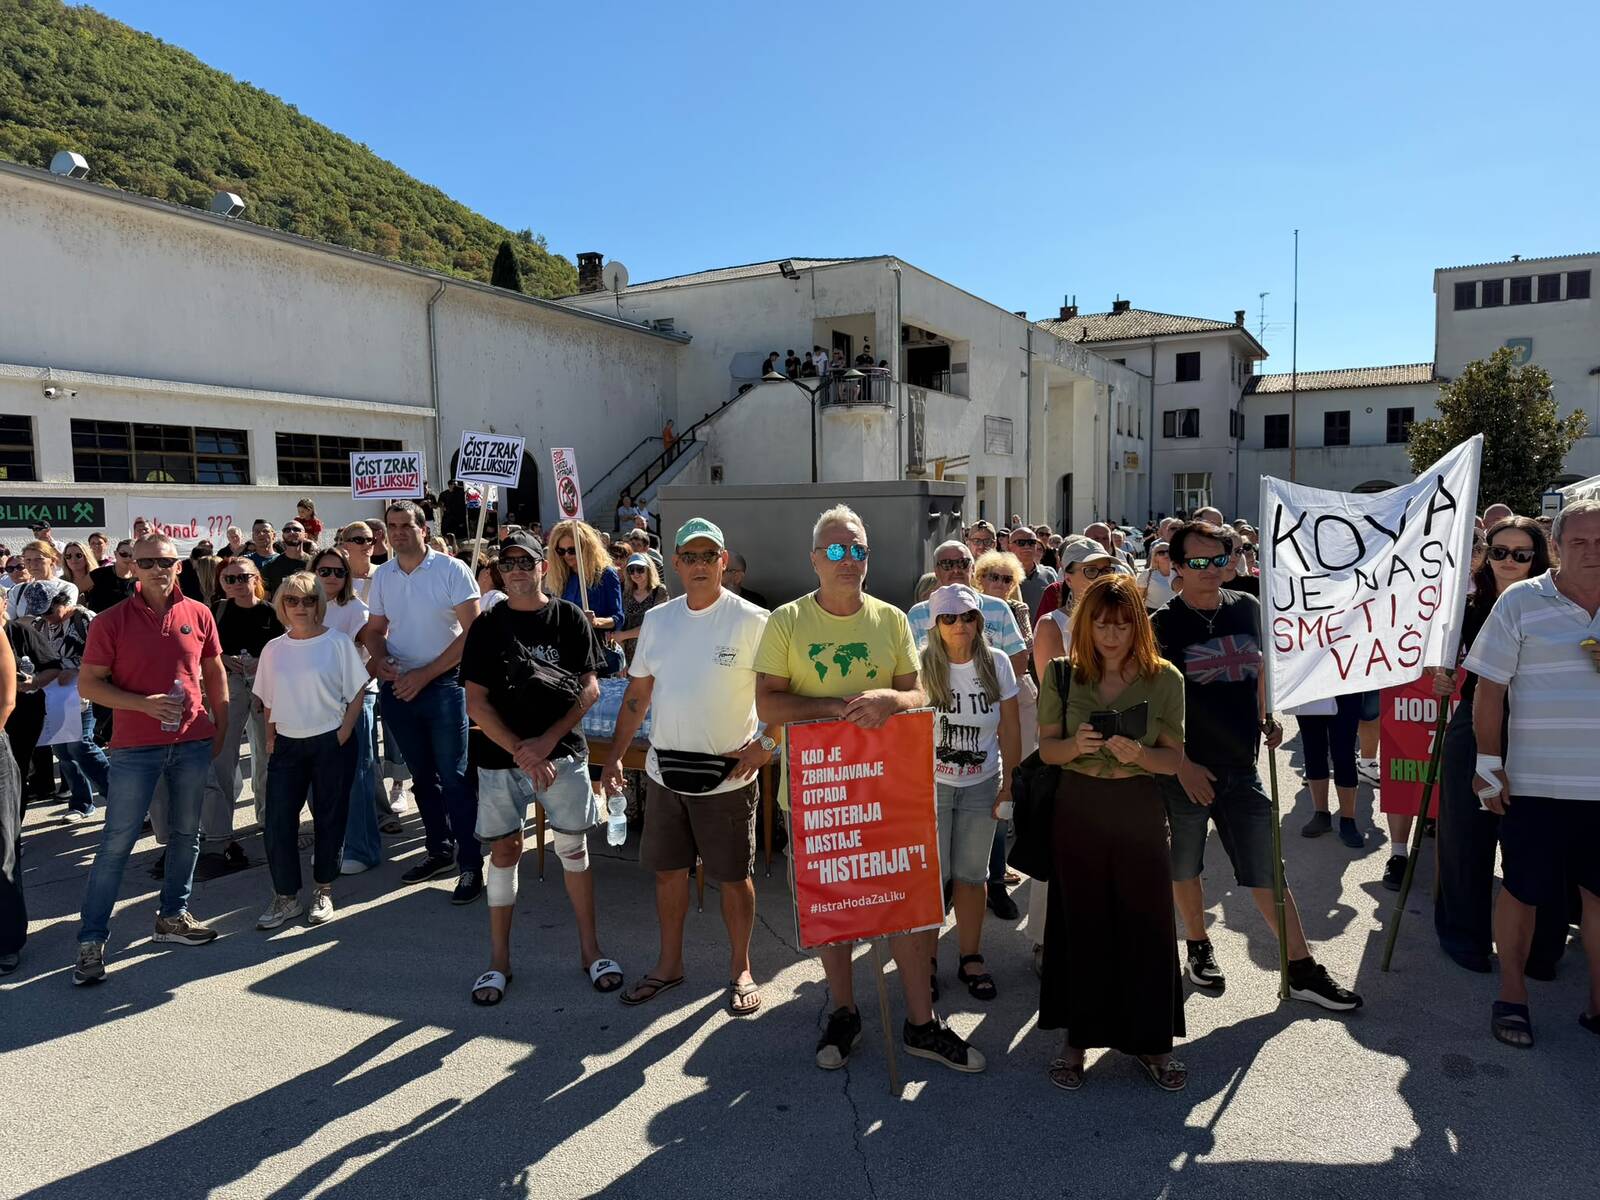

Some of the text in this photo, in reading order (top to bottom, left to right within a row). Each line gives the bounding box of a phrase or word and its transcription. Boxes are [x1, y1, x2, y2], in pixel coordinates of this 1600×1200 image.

[463, 436, 520, 459] ČIST ZRAK
[355, 456, 417, 476] ČIST ZRAK
[461, 457, 518, 476] NIJE LUKSUZ!
[355, 472, 419, 491] NIJE LUKSUZ!
[1272, 474, 1456, 572] KOVA
[1272, 573, 1335, 612] JE
[1330, 624, 1423, 680] VAŠ
[1394, 697, 1461, 723] HOD
[801, 746, 842, 766] KAD JE
[801, 761, 884, 786] ZBRINJAVANJE
[802, 785, 847, 806] OTPADA
[803, 802, 882, 830] MISTERIJA
[805, 830, 862, 854] NASTAJE
[810, 890, 906, 914] #IstraHodaZaLiku
